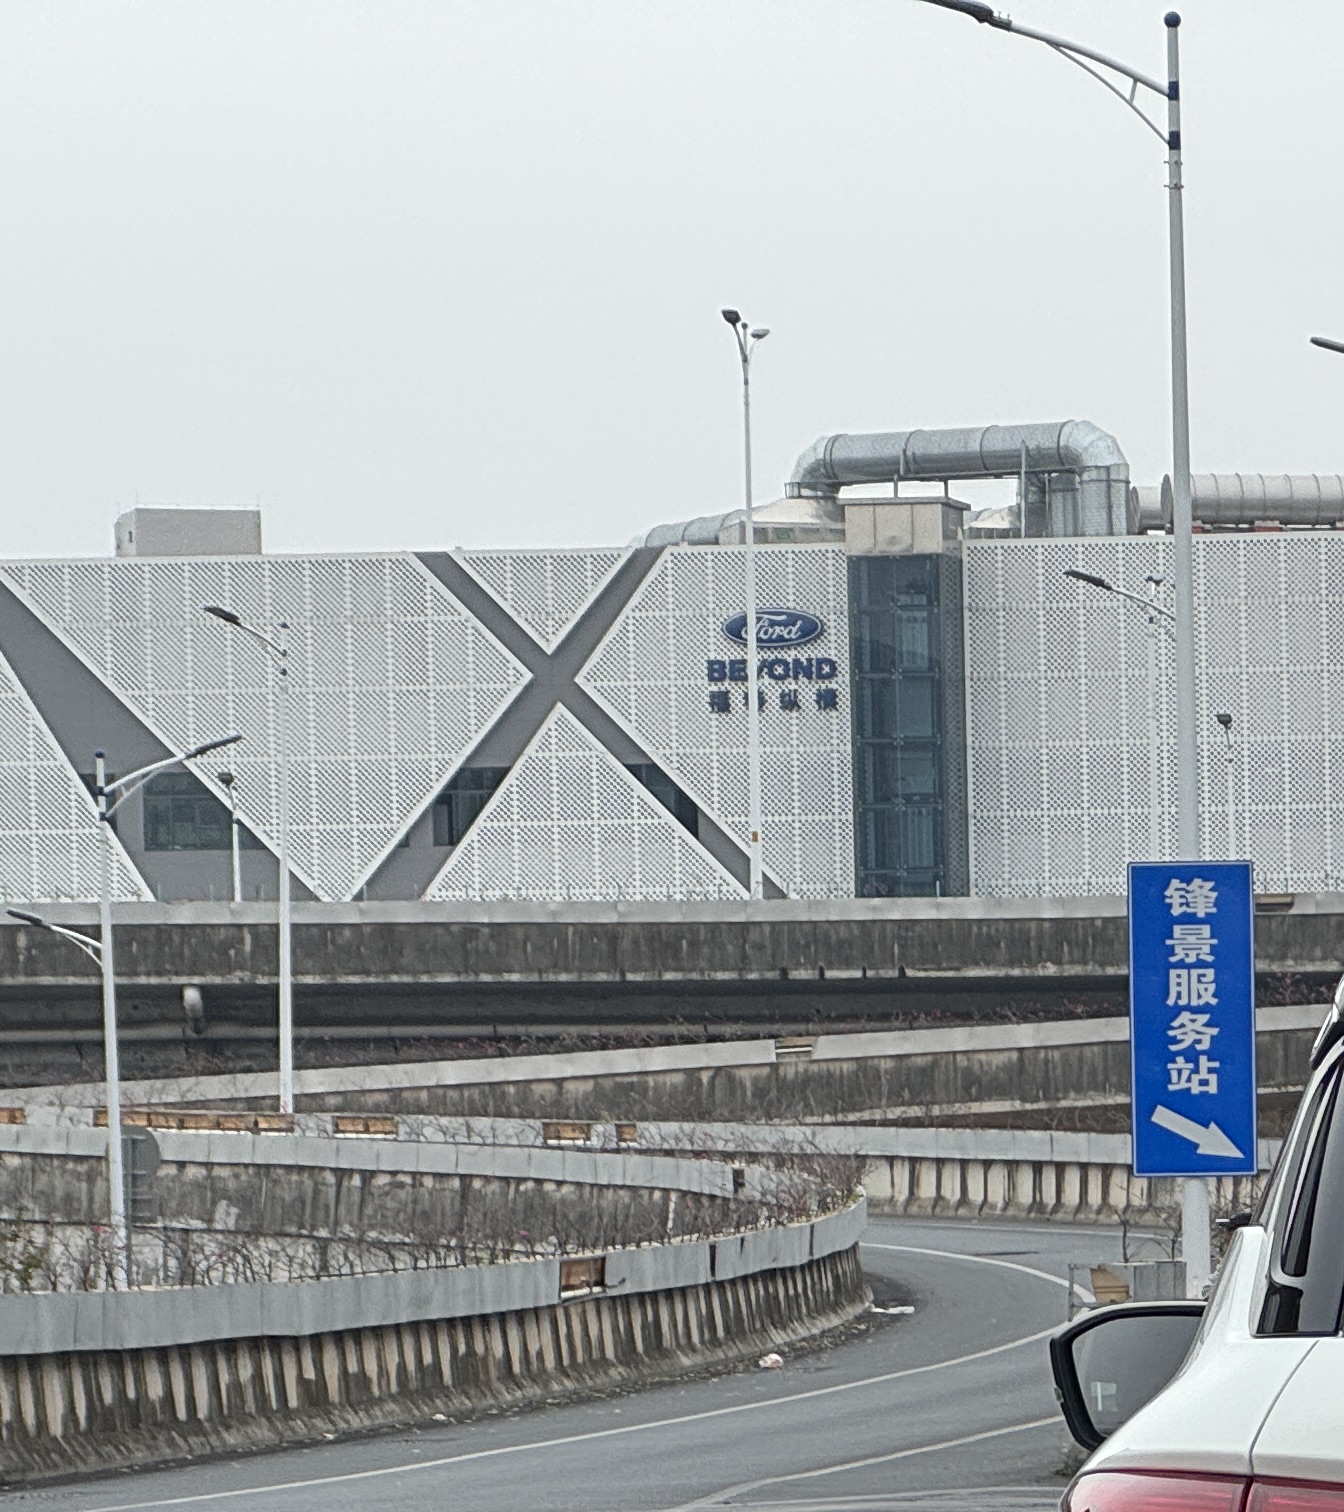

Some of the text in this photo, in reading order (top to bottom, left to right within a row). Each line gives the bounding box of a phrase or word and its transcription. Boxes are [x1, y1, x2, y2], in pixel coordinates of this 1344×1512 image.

[1163, 877, 1220, 1095] 锋景服务站
